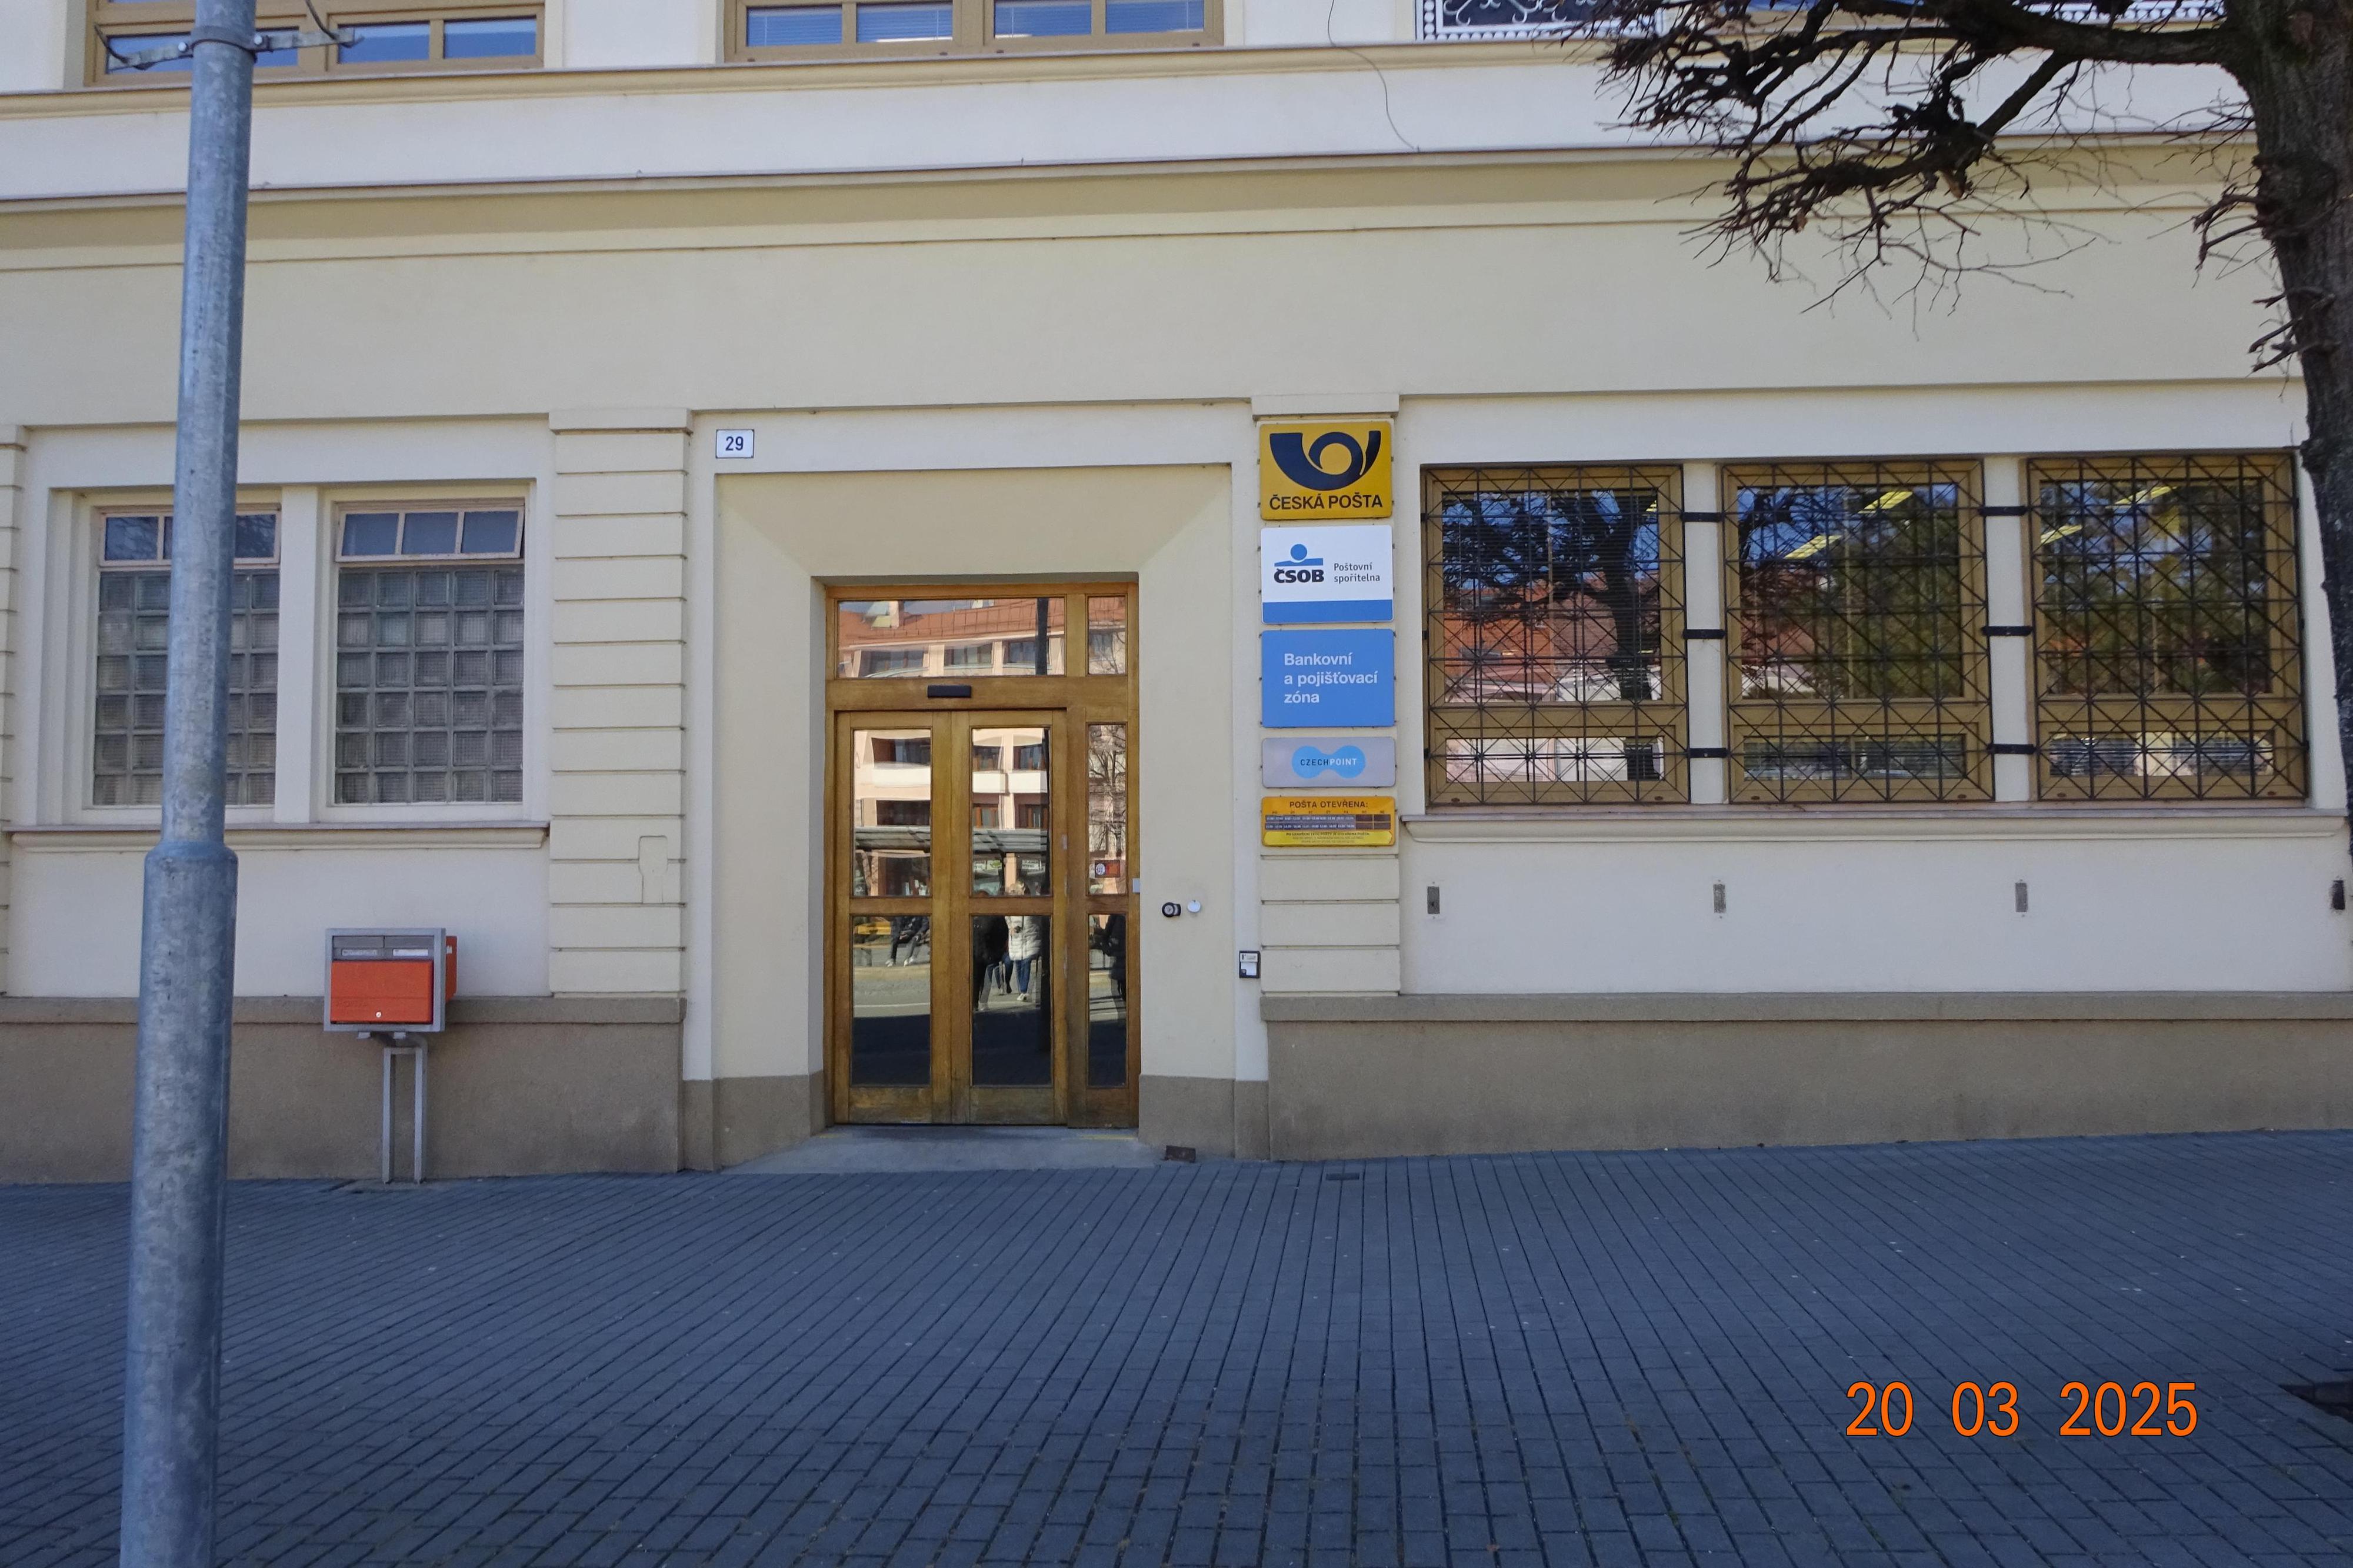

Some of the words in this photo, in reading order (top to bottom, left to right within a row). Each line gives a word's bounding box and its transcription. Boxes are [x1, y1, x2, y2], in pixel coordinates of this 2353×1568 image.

[725, 436, 744, 451] 29
[1269, 493, 1324, 510] ČESKÁ
[1328, 492, 1383, 508] POŠTA
[1334, 562, 1373, 571] Poštovní
[1274, 568, 1324, 583] ČSOB
[1334, 573, 1381, 584] spořitelna
[1284, 652, 1352, 666] Bankovní
[1284, 675, 1292, 685] a
[1298, 670, 1378, 687] pojišťovací
[1284, 690, 1319, 703] zóna
[1289, 799, 1317, 808] POŠTA
[1320, 799, 1368, 808] OTEVŘENA:
